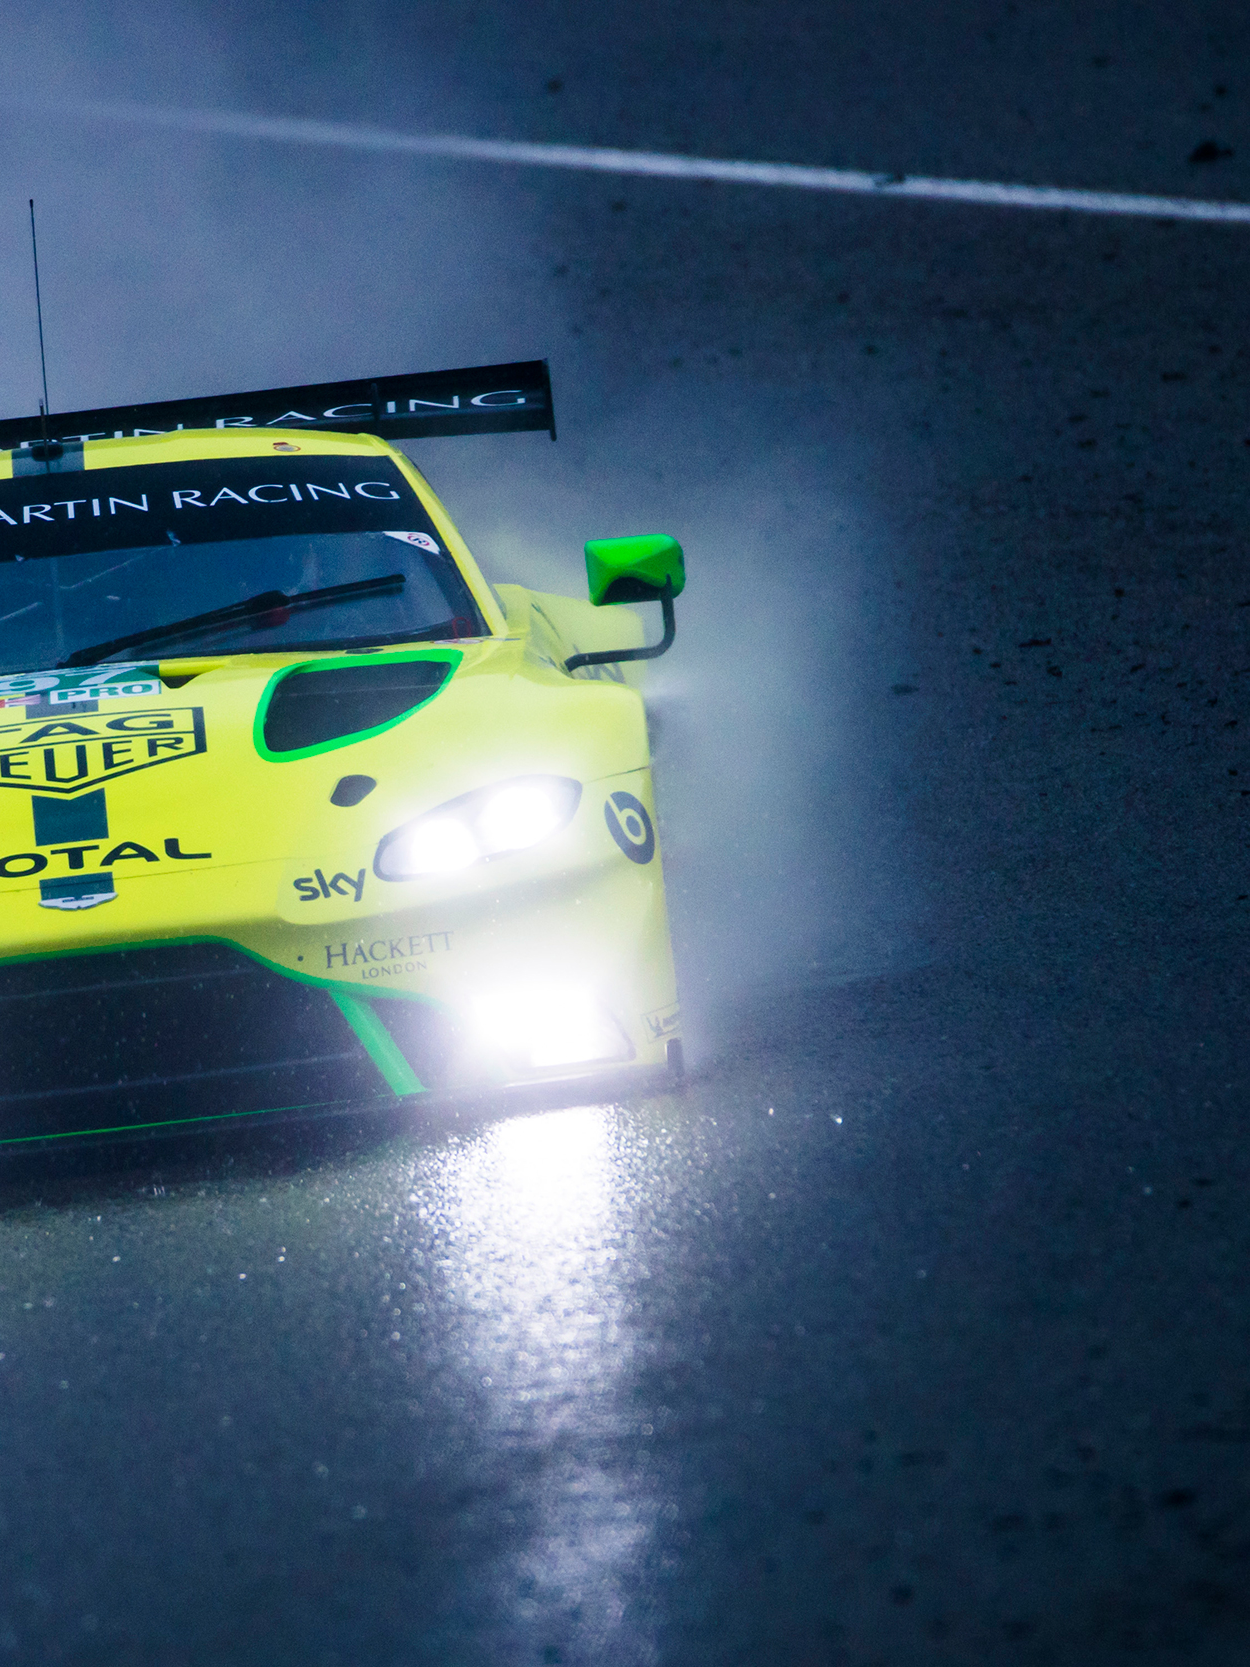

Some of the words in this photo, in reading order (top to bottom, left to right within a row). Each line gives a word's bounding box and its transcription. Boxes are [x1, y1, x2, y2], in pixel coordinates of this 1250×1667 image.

[215, 389, 527, 429] RACING
[171, 481, 401, 510] RACING
[57, 683, 153, 701] PRO
[293, 868, 366, 902] sky
[324, 930, 454, 969] HACKETT
[361, 960, 427, 980] LONDON
